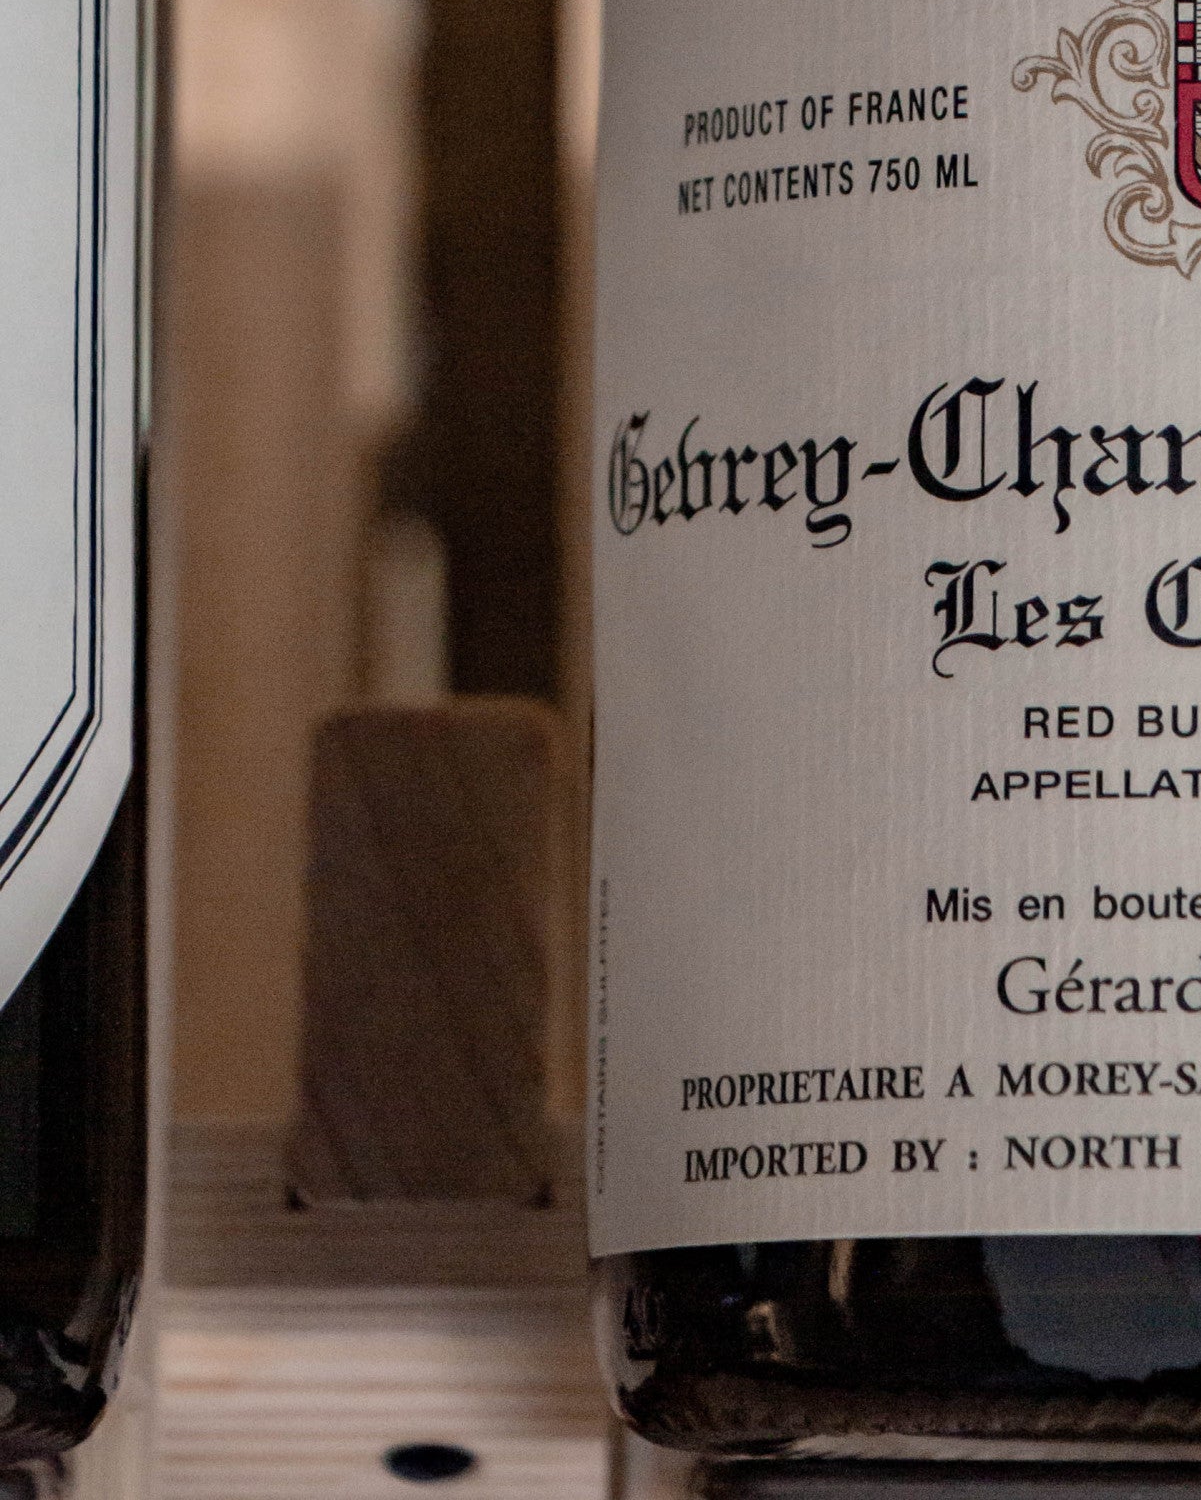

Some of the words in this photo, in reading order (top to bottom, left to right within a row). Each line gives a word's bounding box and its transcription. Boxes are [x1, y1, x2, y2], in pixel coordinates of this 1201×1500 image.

[683, 98, 789, 148] PRODUCT
[800, 93, 835, 132] OF
[847, 84, 969, 128] FRANCE
[677, 175, 715, 216] NET
[723, 159, 855, 209] CONTENTS
[867, 155, 922, 195] 750
[935, 152, 980, 190] ML
[923, 558, 1106, 680] Les
[1022, 704, 1116, 740] RED
[925, 886, 994, 924] Mis
[1016, 892, 1066, 923] en
[680, 1064, 926, 1112] PROPRIETAIRE
[944, 1062, 976, 1099] A
[683, 1139, 869, 1184] IMPORTED
[890, 1136, 948, 1174] BY
[1003, 1133, 1182, 1171] NORTH
